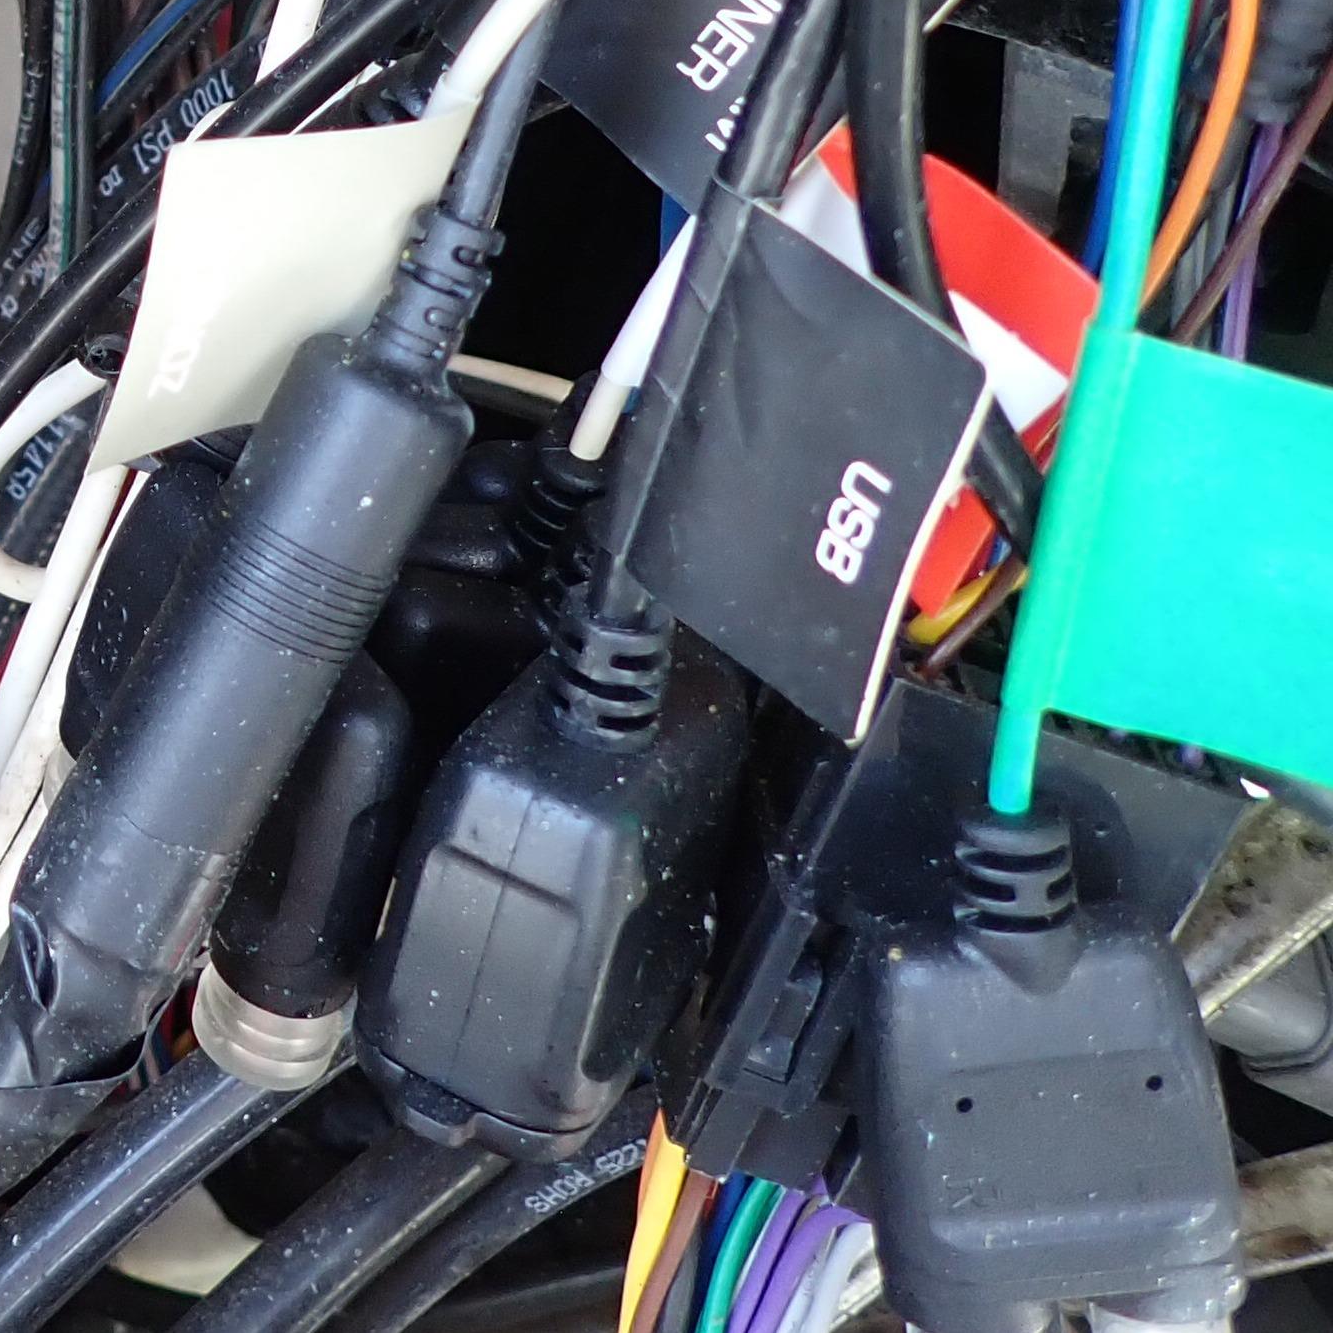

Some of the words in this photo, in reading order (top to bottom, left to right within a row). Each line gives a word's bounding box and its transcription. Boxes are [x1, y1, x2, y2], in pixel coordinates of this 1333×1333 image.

[179, 68, 235, 128] 1000
[133, 118, 175, 175] PSI
[816, 460, 894, 587] USB
